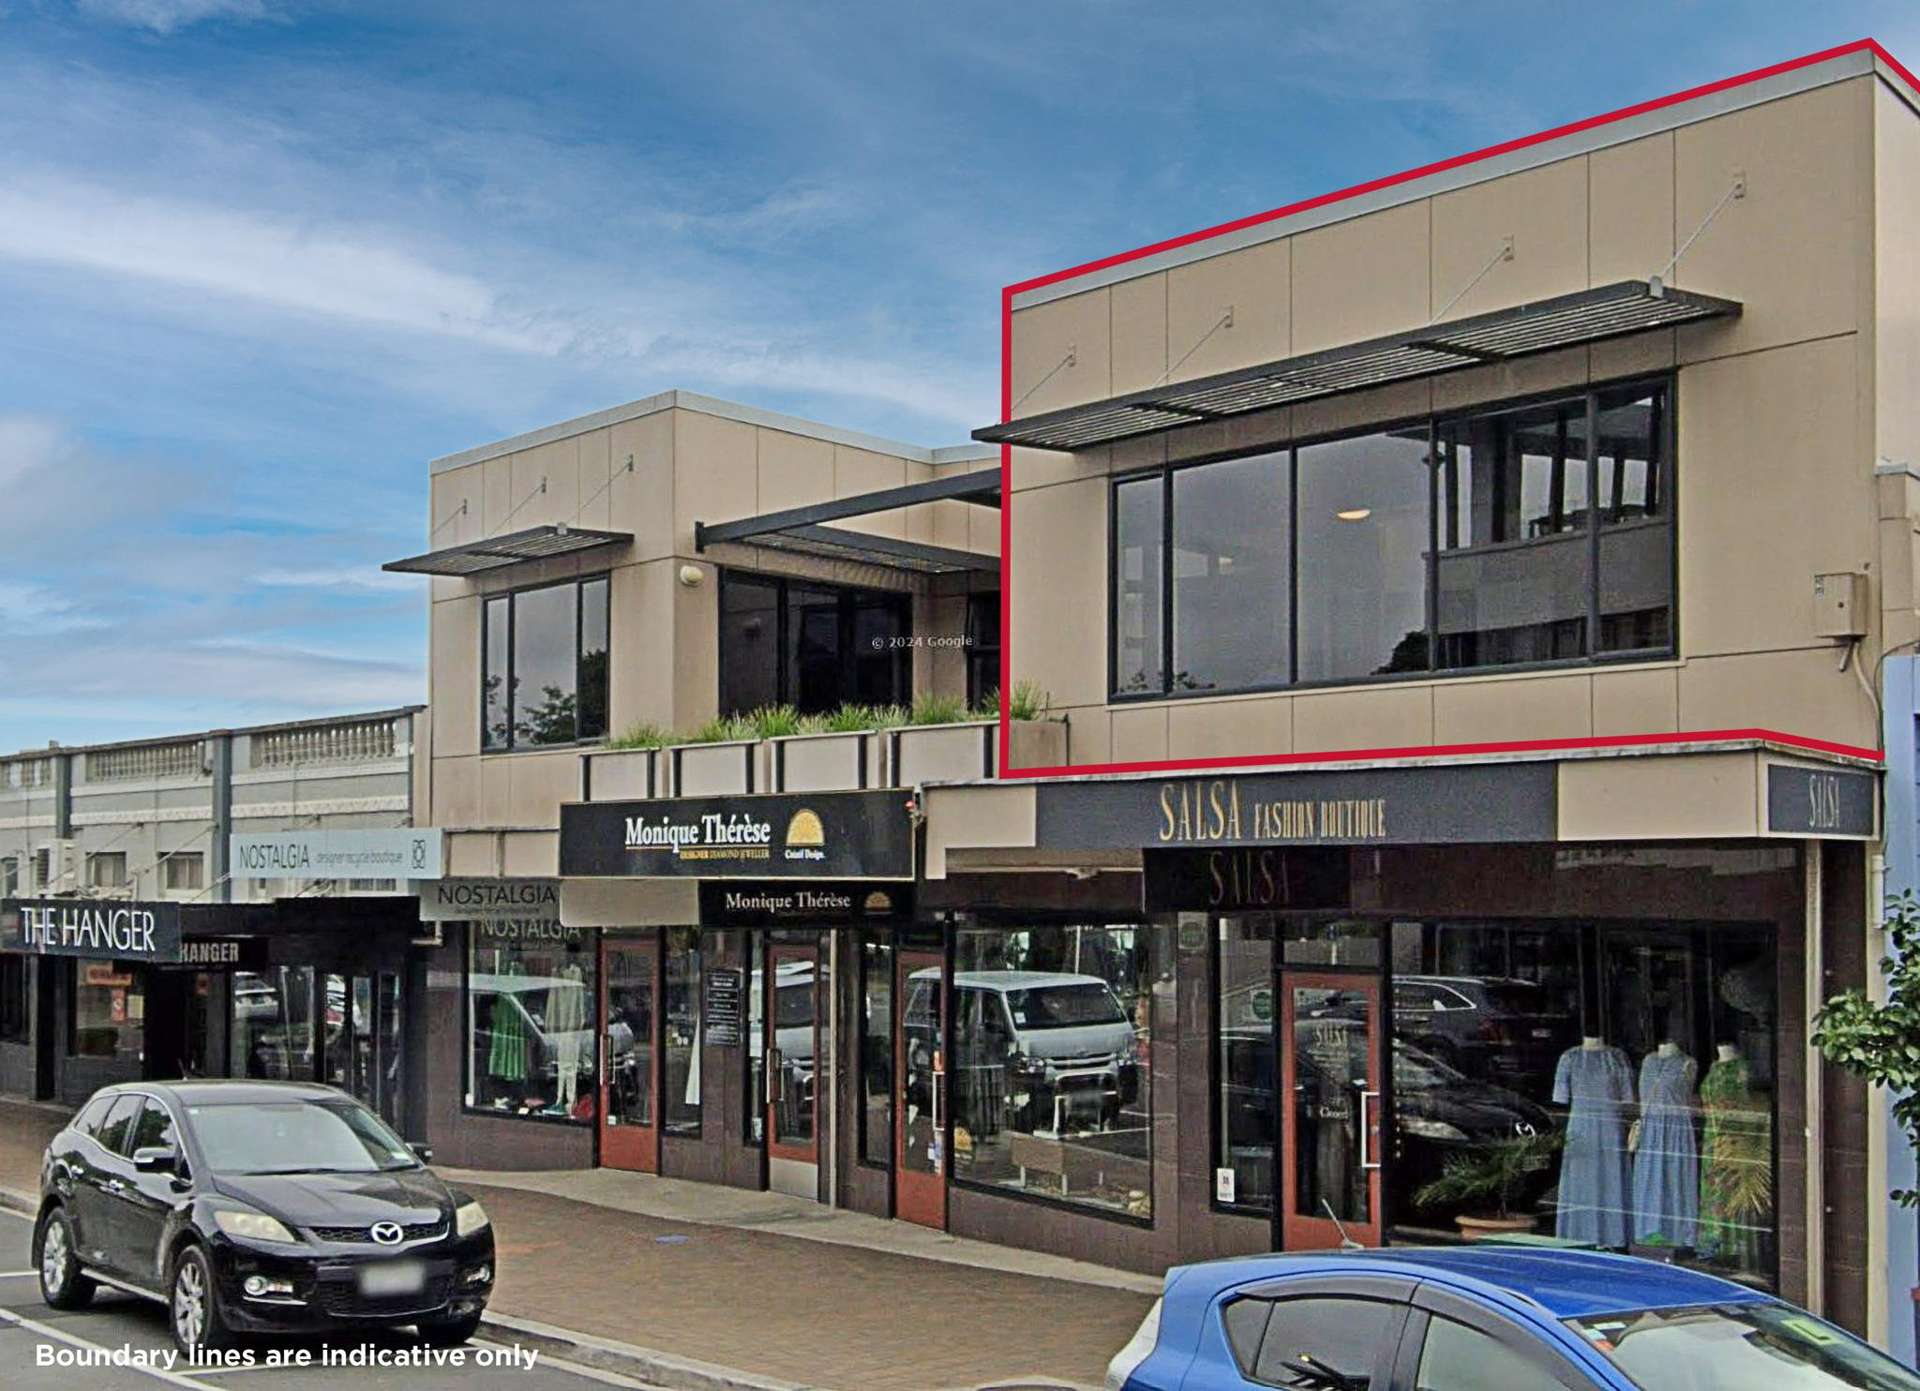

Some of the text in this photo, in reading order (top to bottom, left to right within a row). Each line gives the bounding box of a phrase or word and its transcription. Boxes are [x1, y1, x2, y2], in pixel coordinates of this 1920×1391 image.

[1159, 780, 1387, 841] SALSA FASHION BOUTIQUE
[1808, 774, 1840, 829] SALSA
[625, 813, 771, 854] Monique Thérèse
[239, 845, 311, 869] NOSTALGIA
[438, 885, 557, 905] NOSTALGIA
[726, 891, 851, 913] Monique Thérèse
[21, 907, 156, 952] THE HANGER
[180, 942, 240, 963] HANGER
